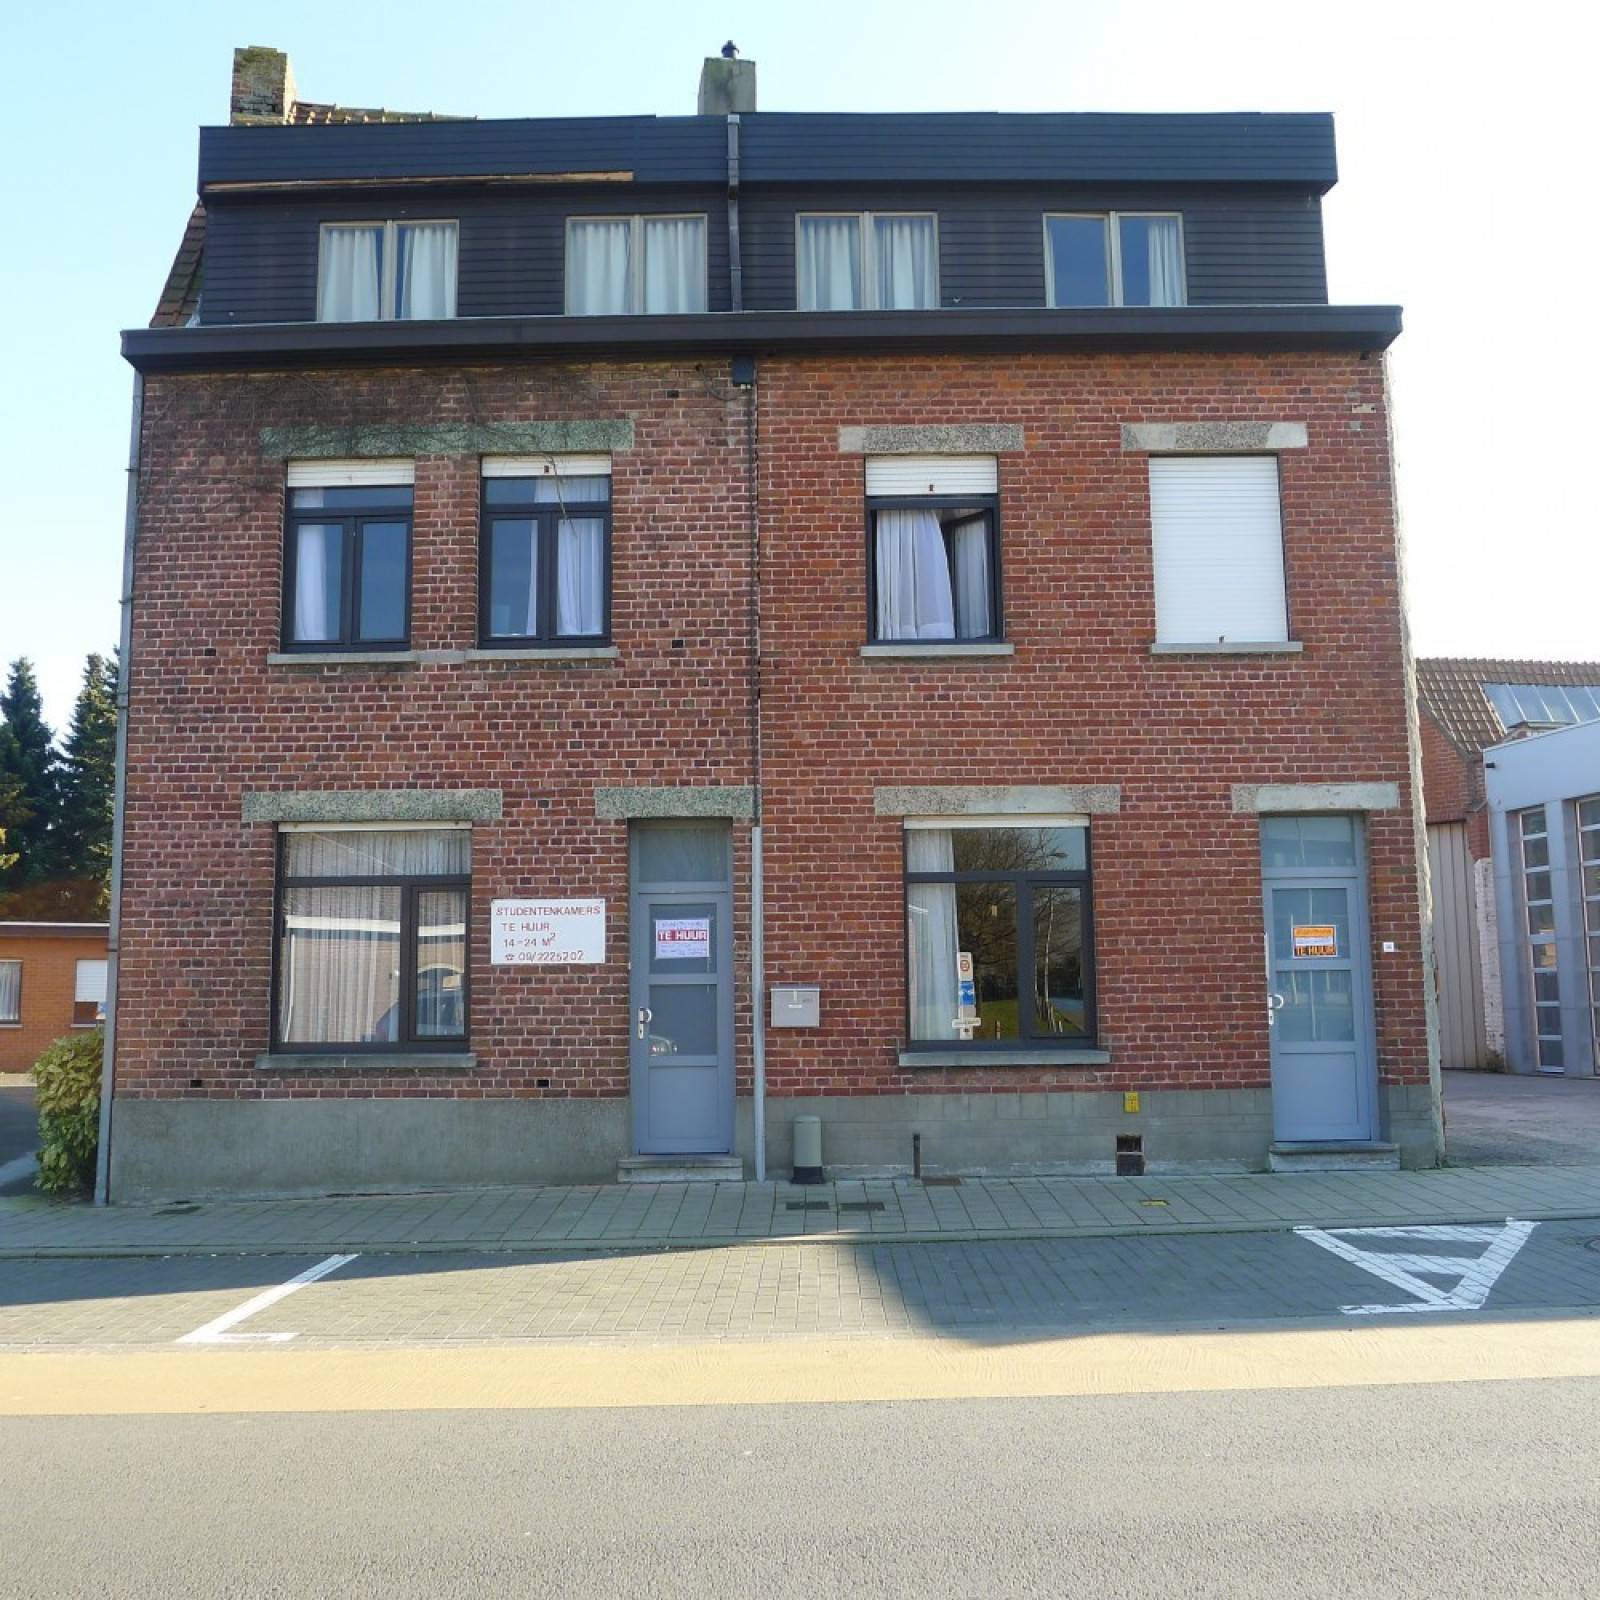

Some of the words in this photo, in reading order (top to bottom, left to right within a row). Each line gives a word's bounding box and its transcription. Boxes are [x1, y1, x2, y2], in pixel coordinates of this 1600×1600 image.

[496, 905, 601, 917] STUDENTENKAMERS
[501, 922, 516, 932] TE
[521, 922, 550, 932] HUUR
[658, 930, 672, 940] TE
[676, 929, 707, 940] HUUR
[1296, 946, 1307, 956] TE
[1308, 945, 1335, 956] HUUR
